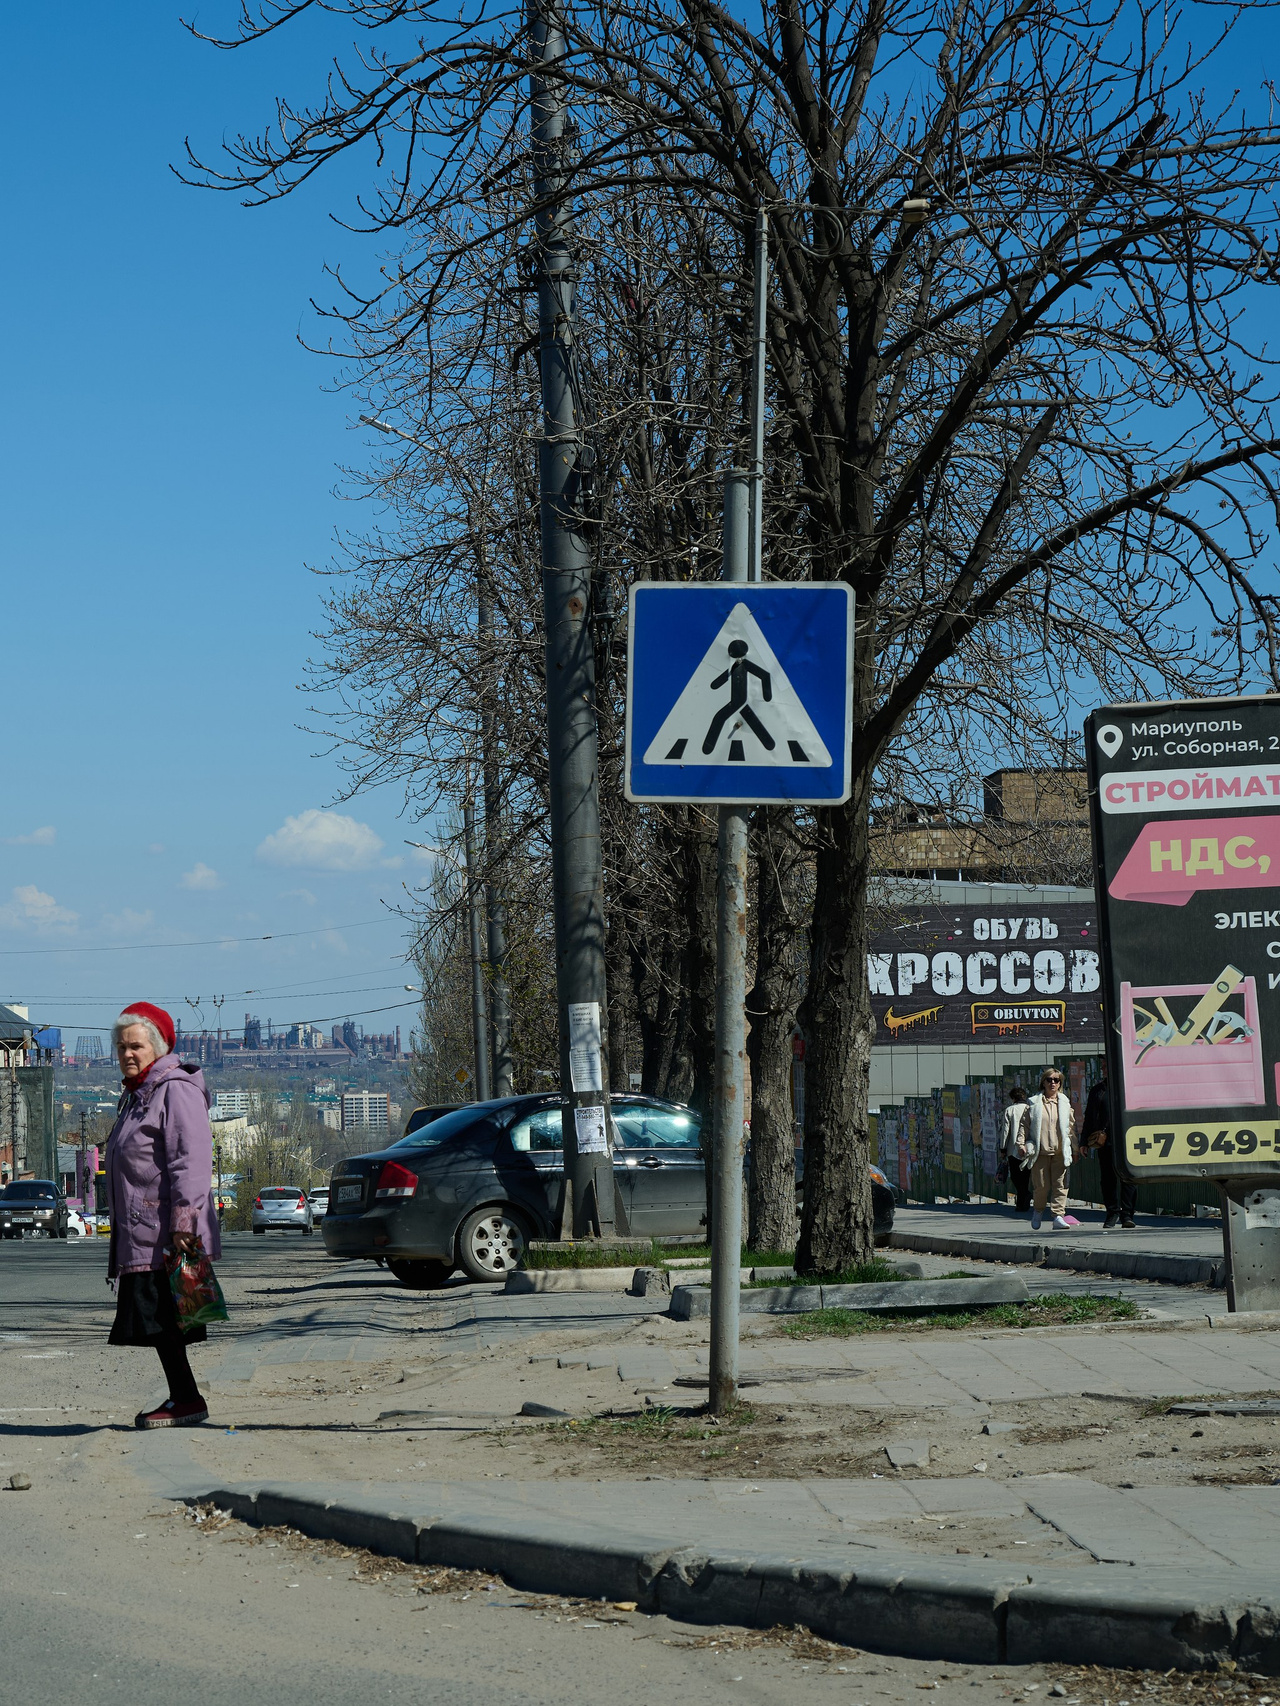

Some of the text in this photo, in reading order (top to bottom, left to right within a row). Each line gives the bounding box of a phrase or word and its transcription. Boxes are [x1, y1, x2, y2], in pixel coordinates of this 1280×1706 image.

[1132, 721, 1243, 738] Мариуполь
[1132, 744, 1158, 761] ул.
[1164, 739, 1264, 757] Соборная,
[1105, 773, 1280, 804] СТРОЙМАТ
[1149, 835, 1272, 877] НДС,
[973, 917, 1059, 941] ОБУВЬ
[1214, 910, 1280, 930] ЭЛЕК
[993, 1007, 1059, 1020] OBUVTON
[1133, 1132, 1175, 1158] +7
